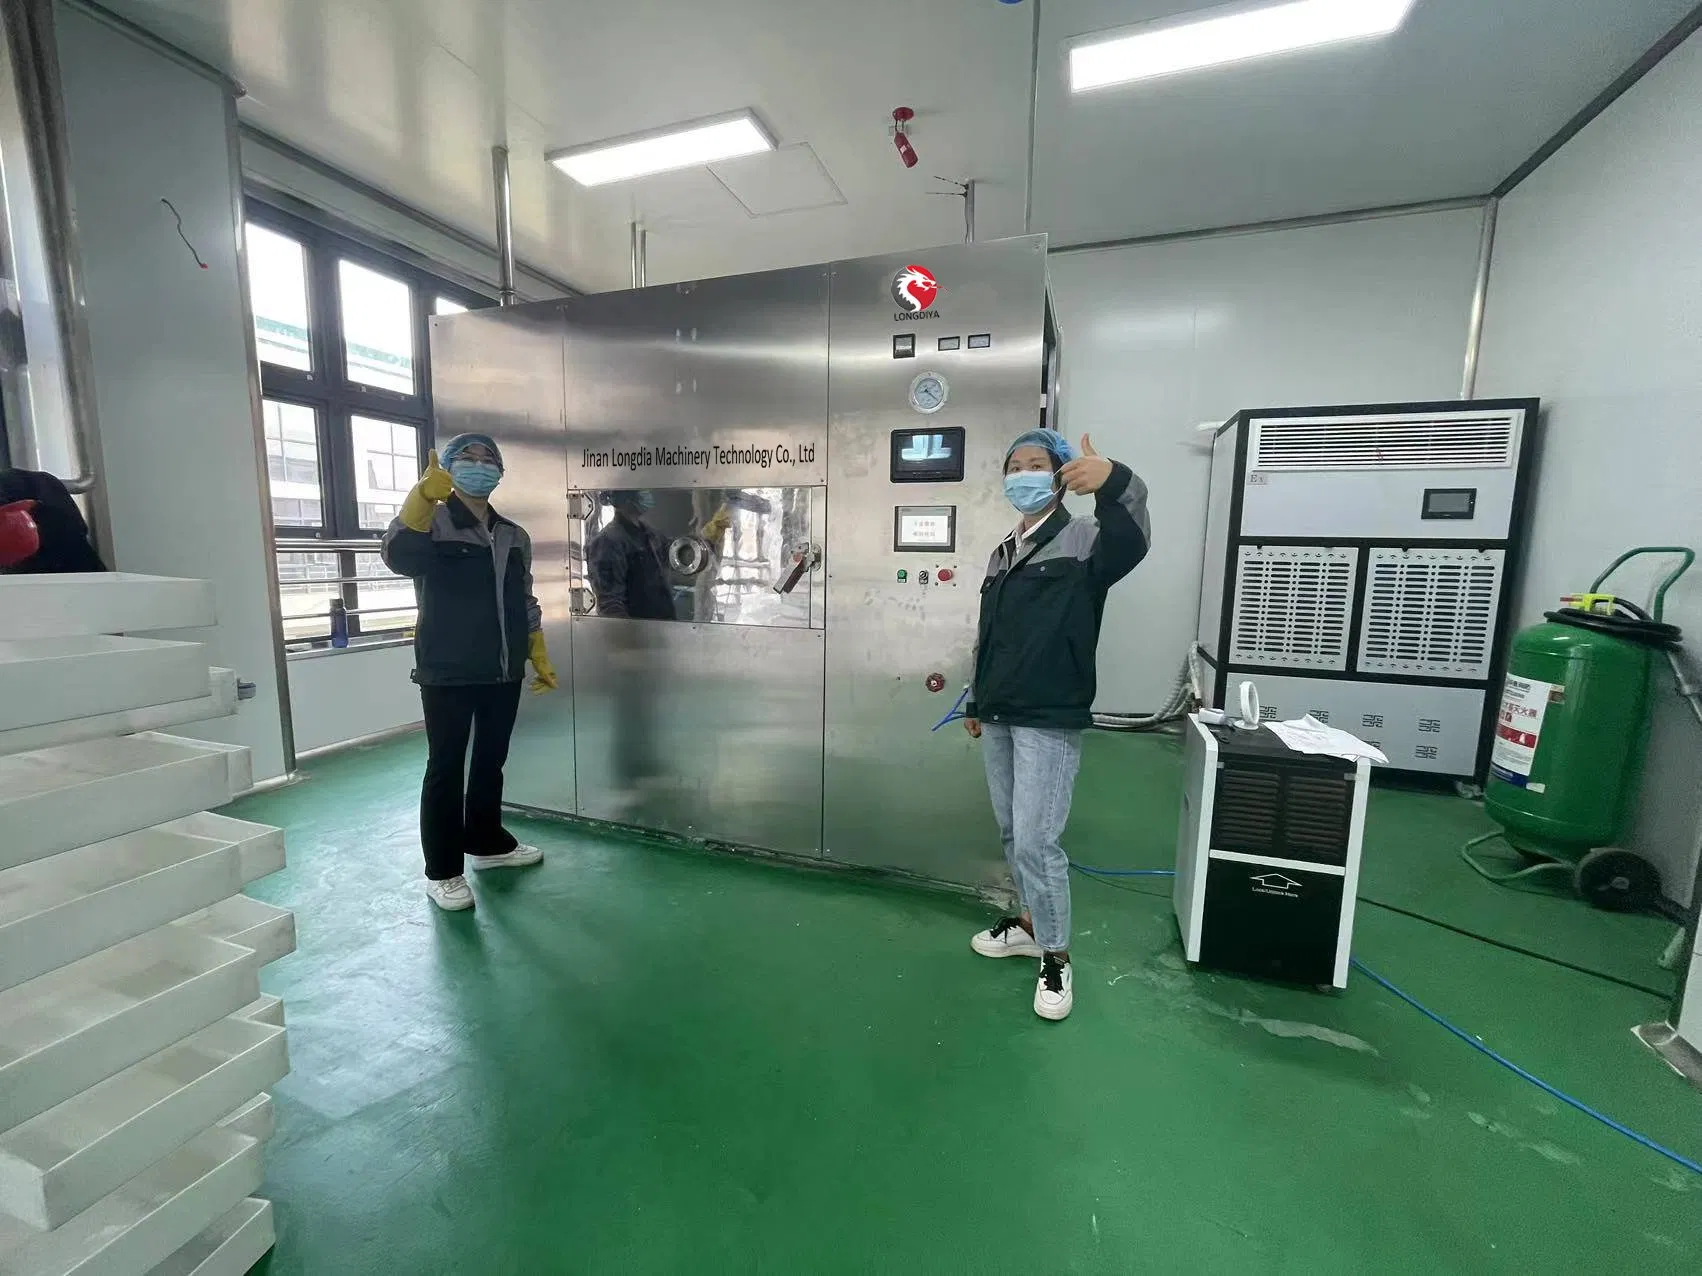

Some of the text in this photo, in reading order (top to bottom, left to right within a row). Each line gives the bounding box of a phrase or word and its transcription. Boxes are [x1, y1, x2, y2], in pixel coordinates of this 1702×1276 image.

[894, 310, 940, 321] LONGDIYA
[581, 443, 815, 471] Jinan Longdia Machinery Technology Co., Ltd
